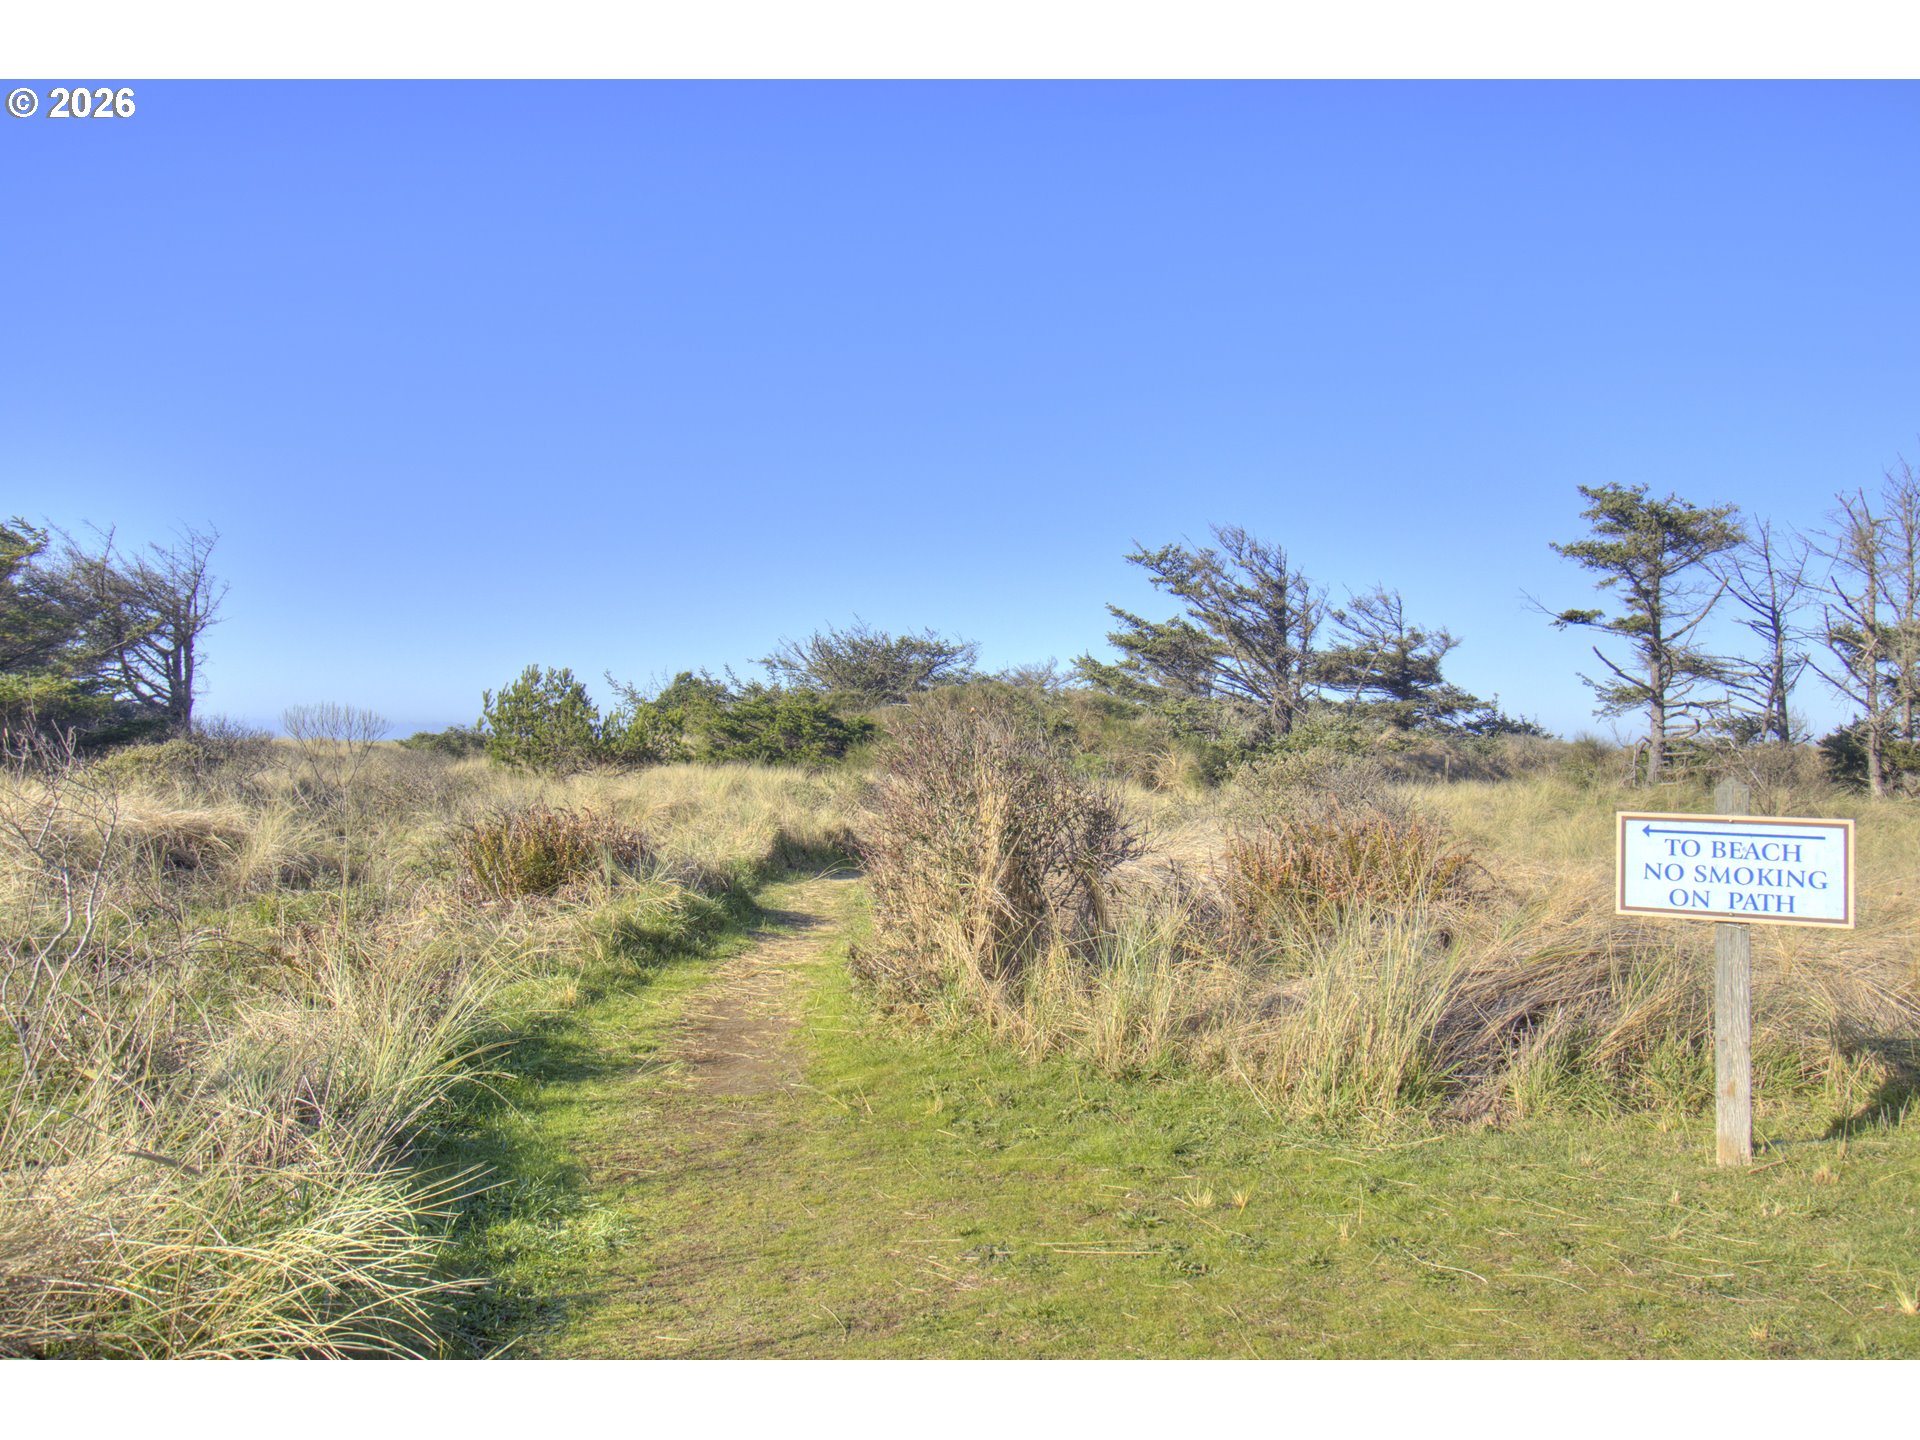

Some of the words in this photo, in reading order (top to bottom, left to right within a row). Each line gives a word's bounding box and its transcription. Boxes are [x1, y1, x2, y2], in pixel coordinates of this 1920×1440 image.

[1664, 838, 1701, 858] TO
[1711, 840, 1802, 863] BEACH
[1643, 862, 1685, 881] NO
[1694, 864, 1828, 890] SMOKING
[1669, 888, 1710, 909] ON
[1728, 891, 1796, 914] PATH
